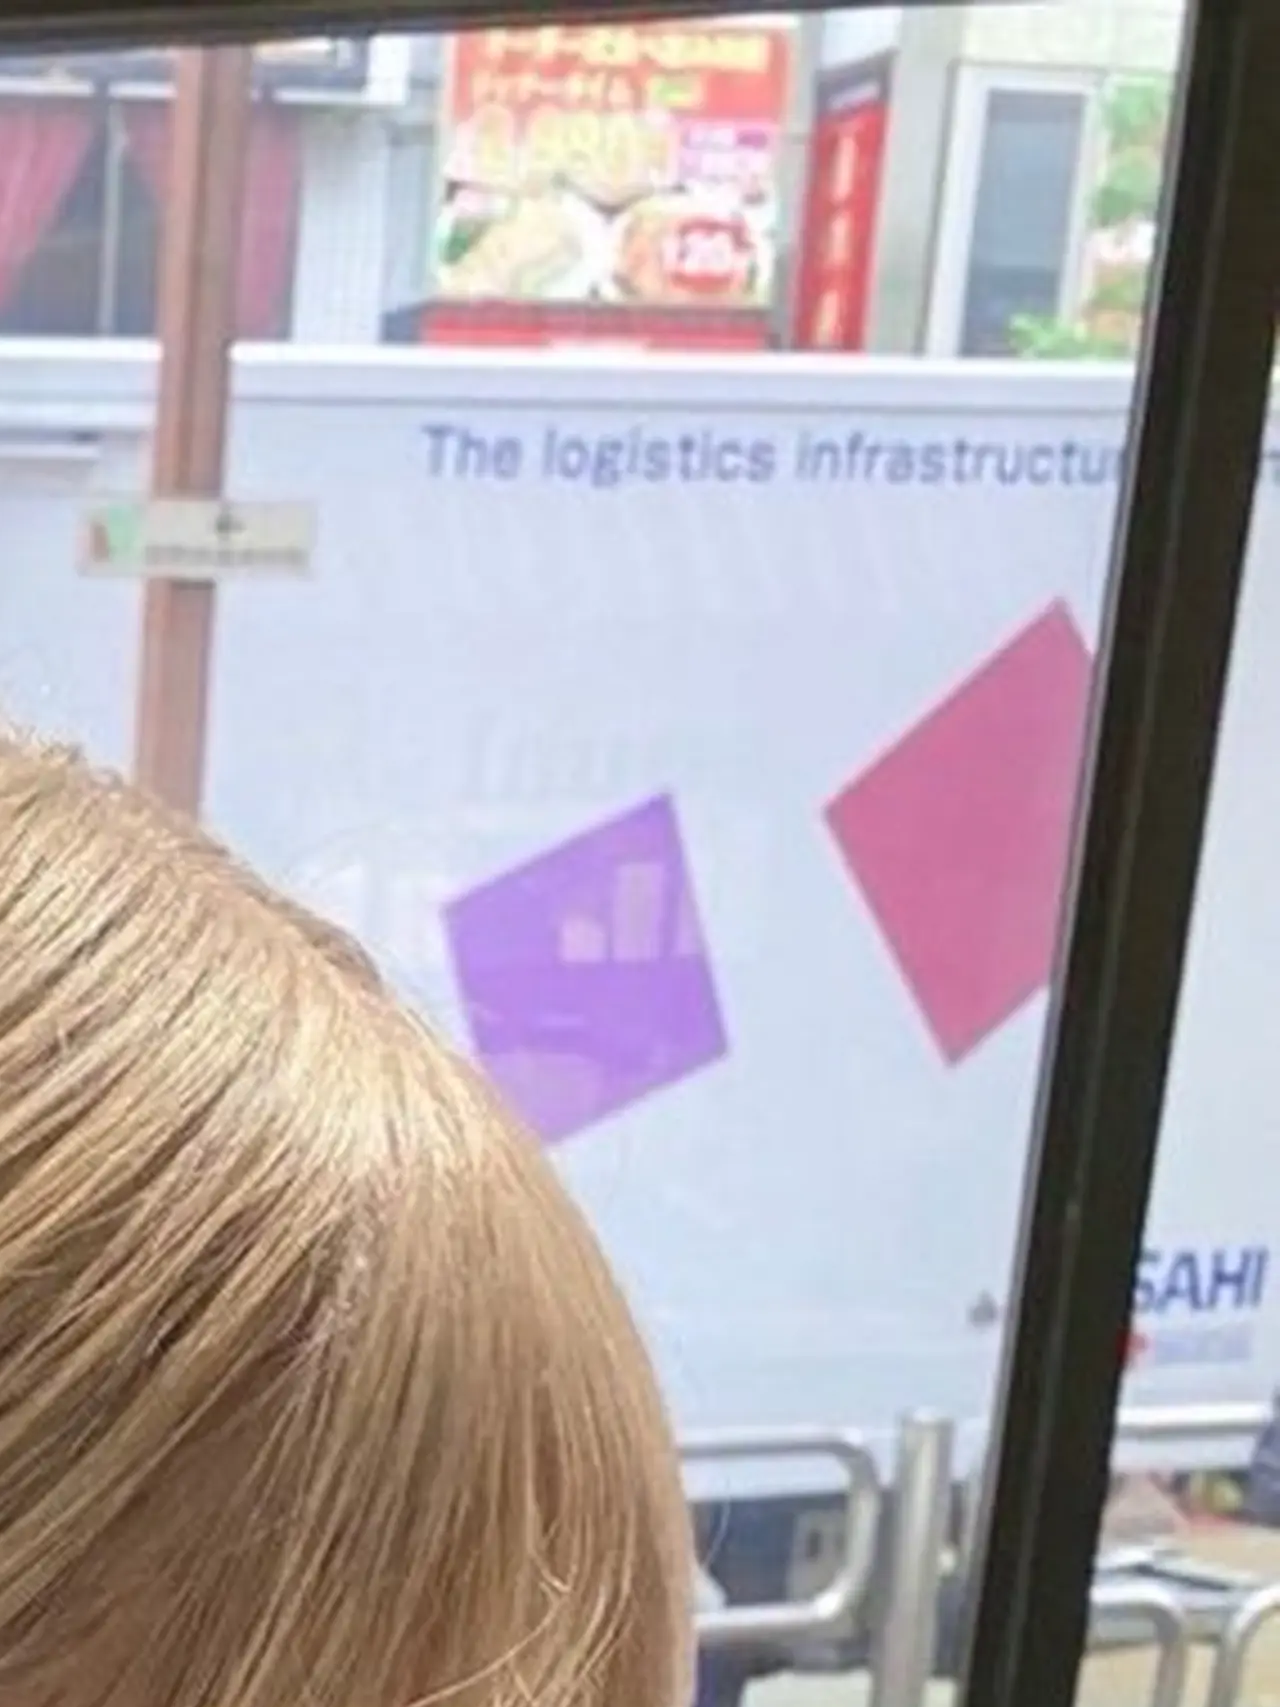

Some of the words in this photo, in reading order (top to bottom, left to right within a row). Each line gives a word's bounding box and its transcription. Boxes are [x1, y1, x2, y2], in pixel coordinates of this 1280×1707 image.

[420, 424, 522, 480] The
[541, 422, 778, 488] logistics
[793, 429, 1124, 486] infrastructu
[1135, 1246, 1269, 1312] SAHI
